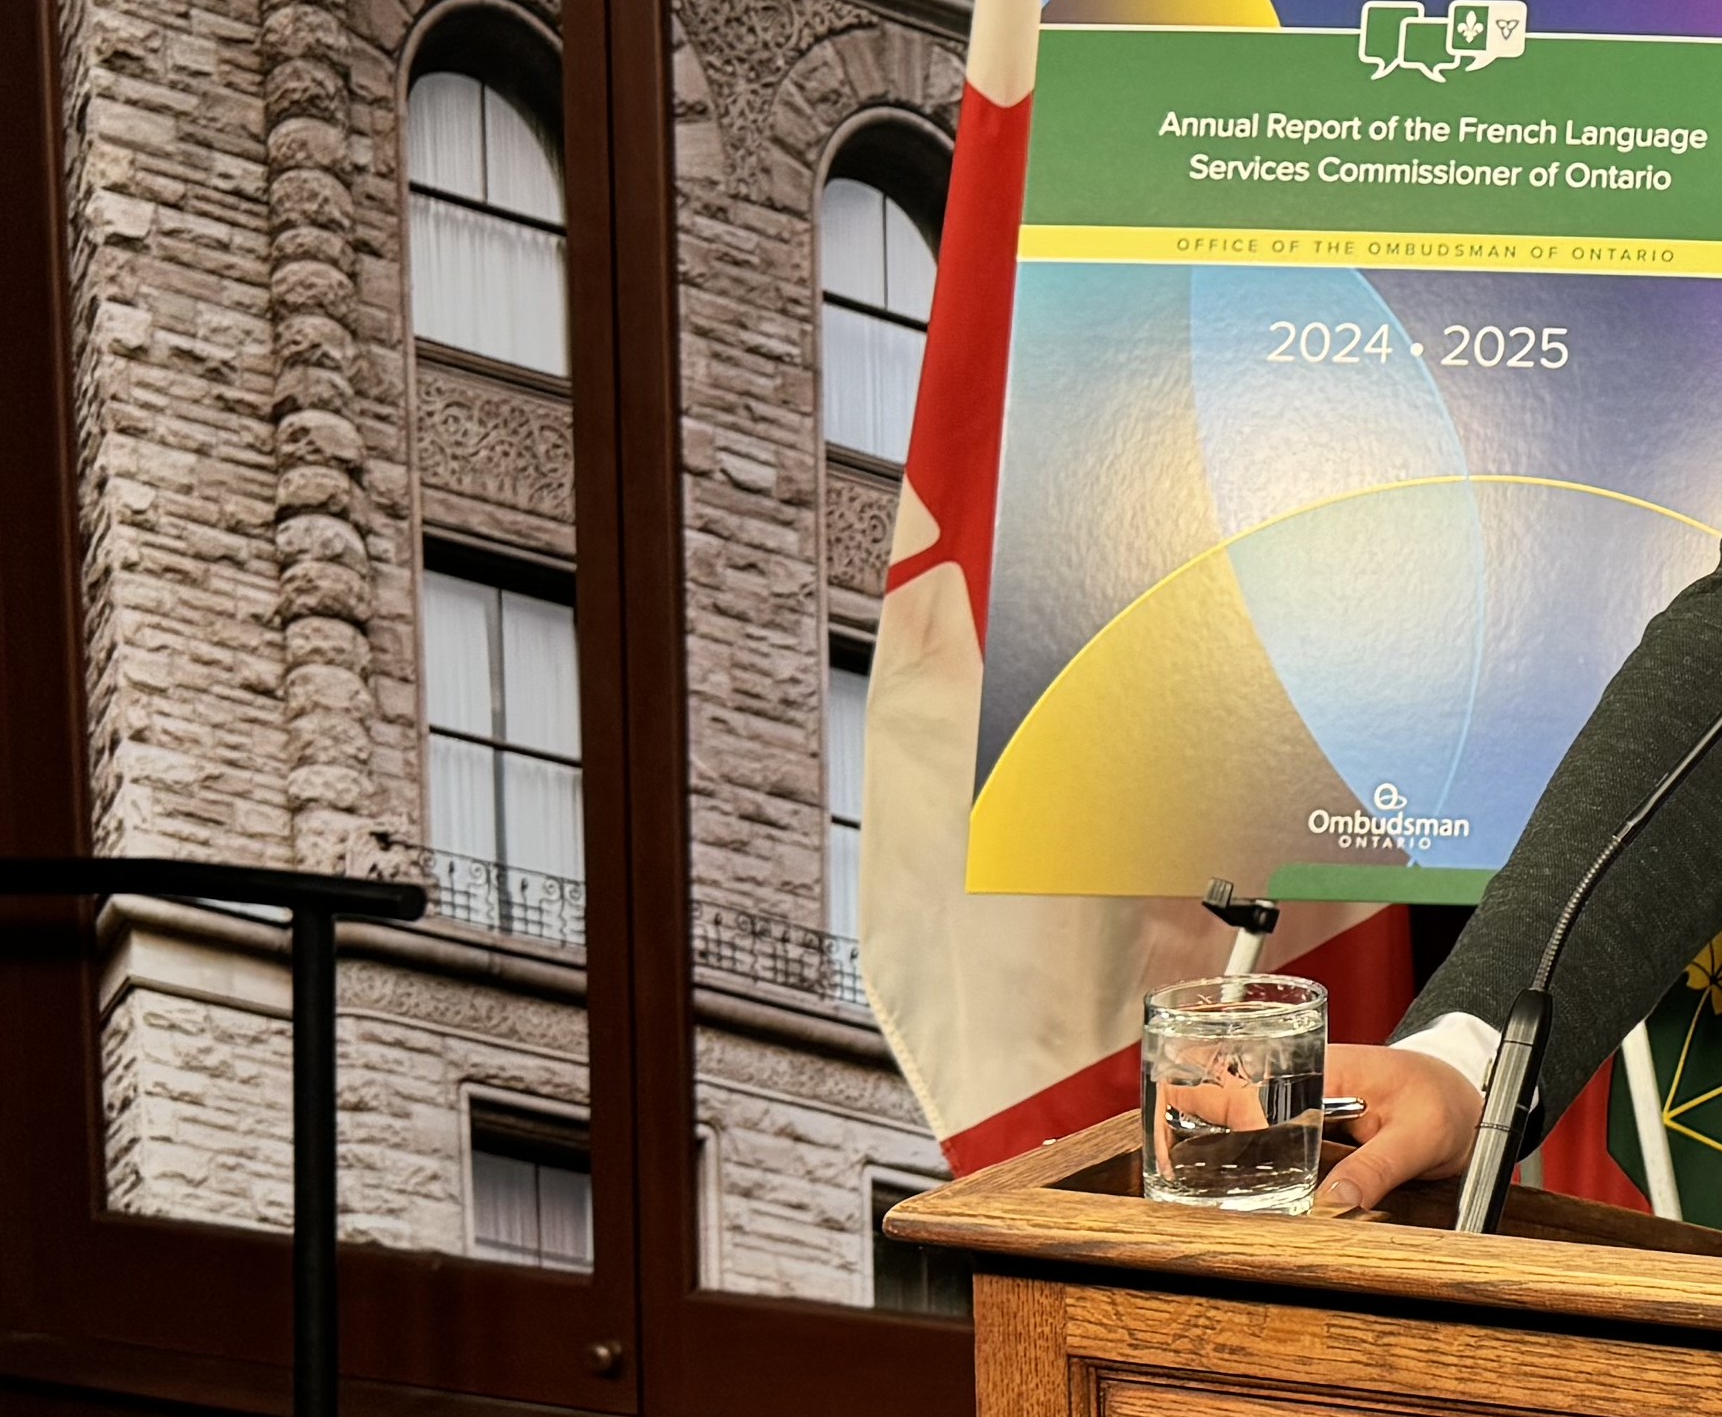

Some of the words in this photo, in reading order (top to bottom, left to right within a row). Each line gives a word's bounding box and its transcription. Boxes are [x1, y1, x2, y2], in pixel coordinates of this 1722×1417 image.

[1158, 111, 1260, 138] Annual
[1266, 112, 1362, 145] Report
[1368, 115, 1400, 141] of
[1404, 116, 1451, 142] the
[1458, 116, 1557, 145] French
[1565, 119, 1708, 155] Language
[1189, 153, 1310, 182] Services
[1317, 156, 1523, 187] Commissioner
[1528, 161, 1560, 187] of
[1565, 162, 1672, 191] Ontario
[1176, 237, 1259, 255] OFFICE
[1271, 239, 1301, 255] OF
[1313, 240, 1356, 256] THE
[1367, 241, 1519, 259] OMBUDSMAN
[1530, 245, 1559, 261] OF
[1571, 246, 1677, 264] ONTARIO
[1266, 320, 1393, 365] 2024
[1440, 324, 1569, 369] 2025
[1308, 809, 1470, 837] Ombudsman
[1339, 836, 1432, 850] ONTARIO
